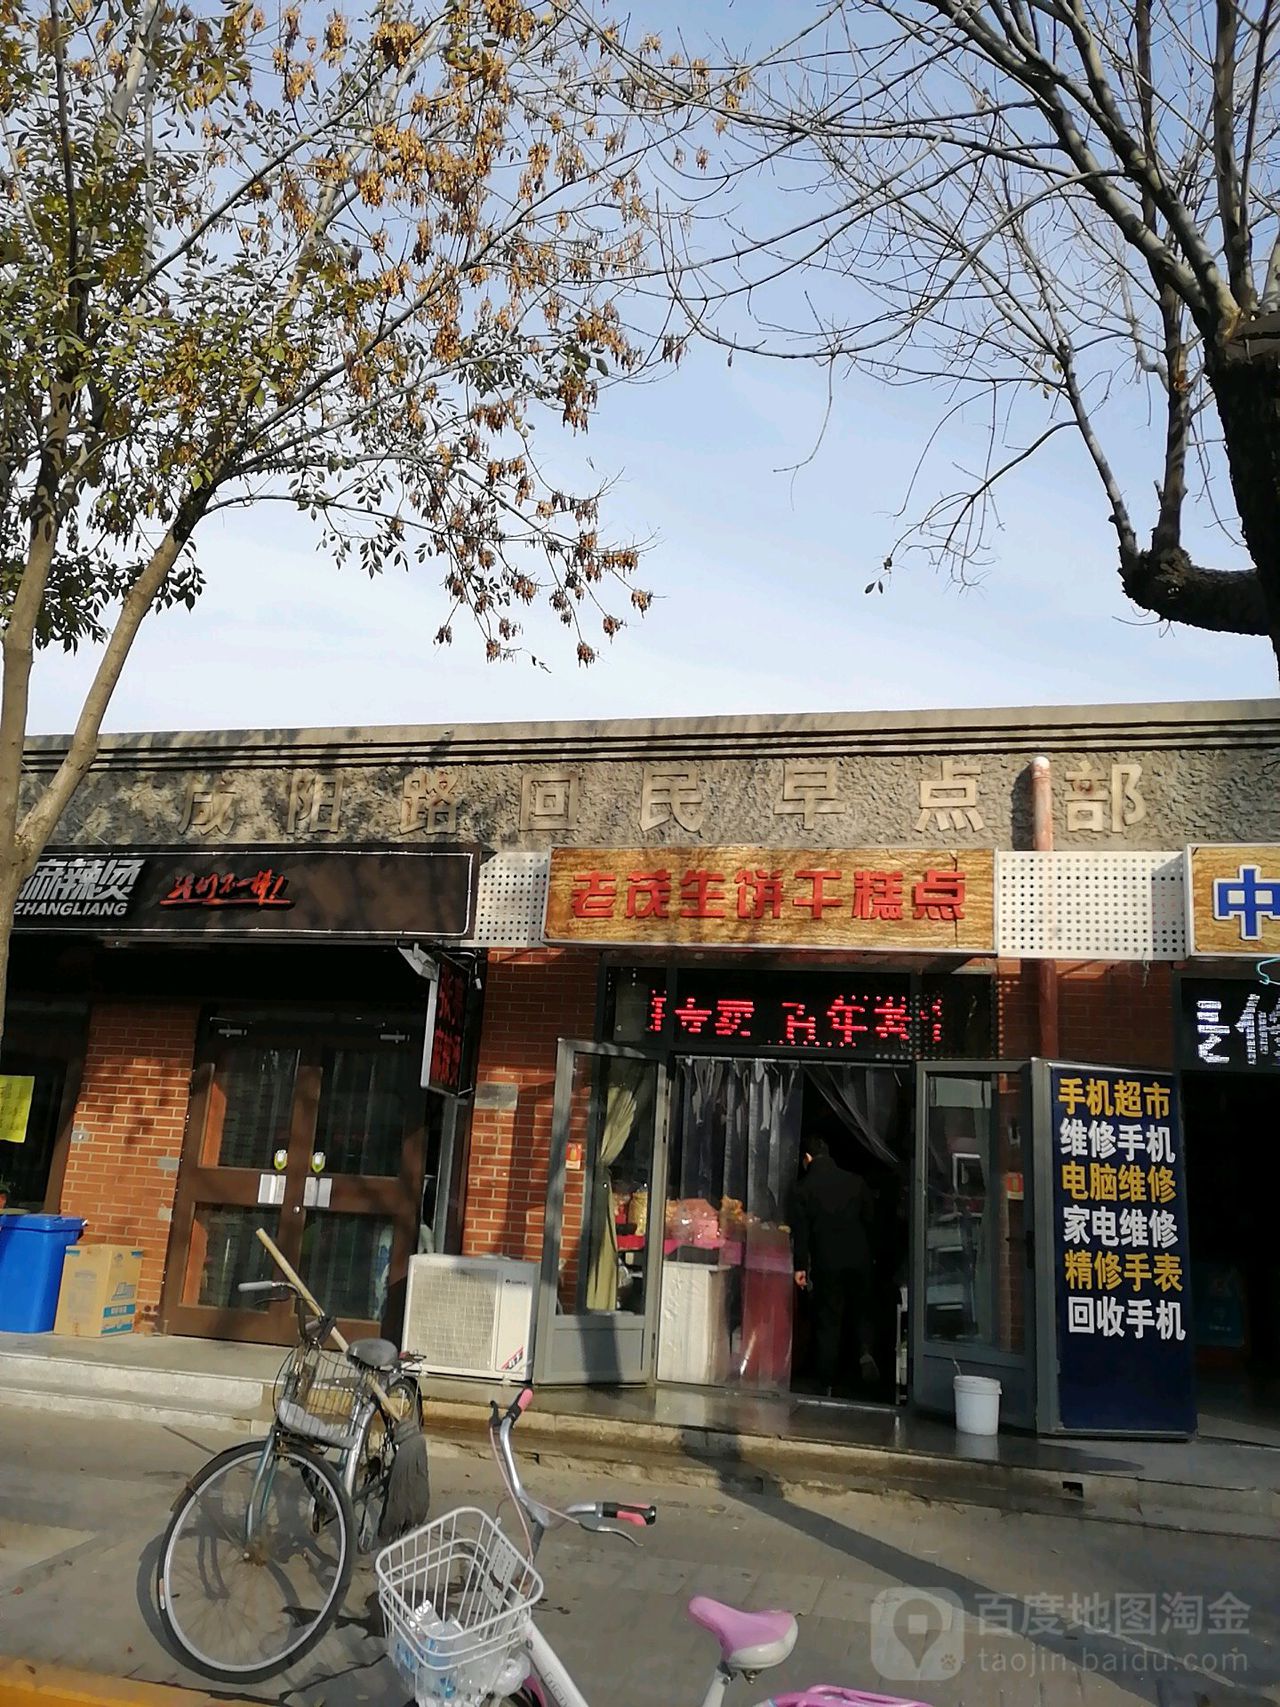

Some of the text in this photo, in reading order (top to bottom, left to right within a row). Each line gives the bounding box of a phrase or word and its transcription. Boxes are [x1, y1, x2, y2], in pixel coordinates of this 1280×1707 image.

[18, 858, 146, 900] 麻辣烫
[571, 869, 966, 920] 老茂生饼干糕点
[14, 902, 128, 916] ZHANGLIANG
[1213, 865, 1280, 940] 中
[1058, 1078, 1171, 1120] 手机超市
[1059, 1118, 1176, 1164] 维修手机
[1061, 1161, 1177, 1205] 电脑维修
[1063, 1205, 1178, 1249] 家电维修
[1065, 1249, 1183, 1292] 精修手表
[1067, 1296, 1187, 1341] 回收手机
